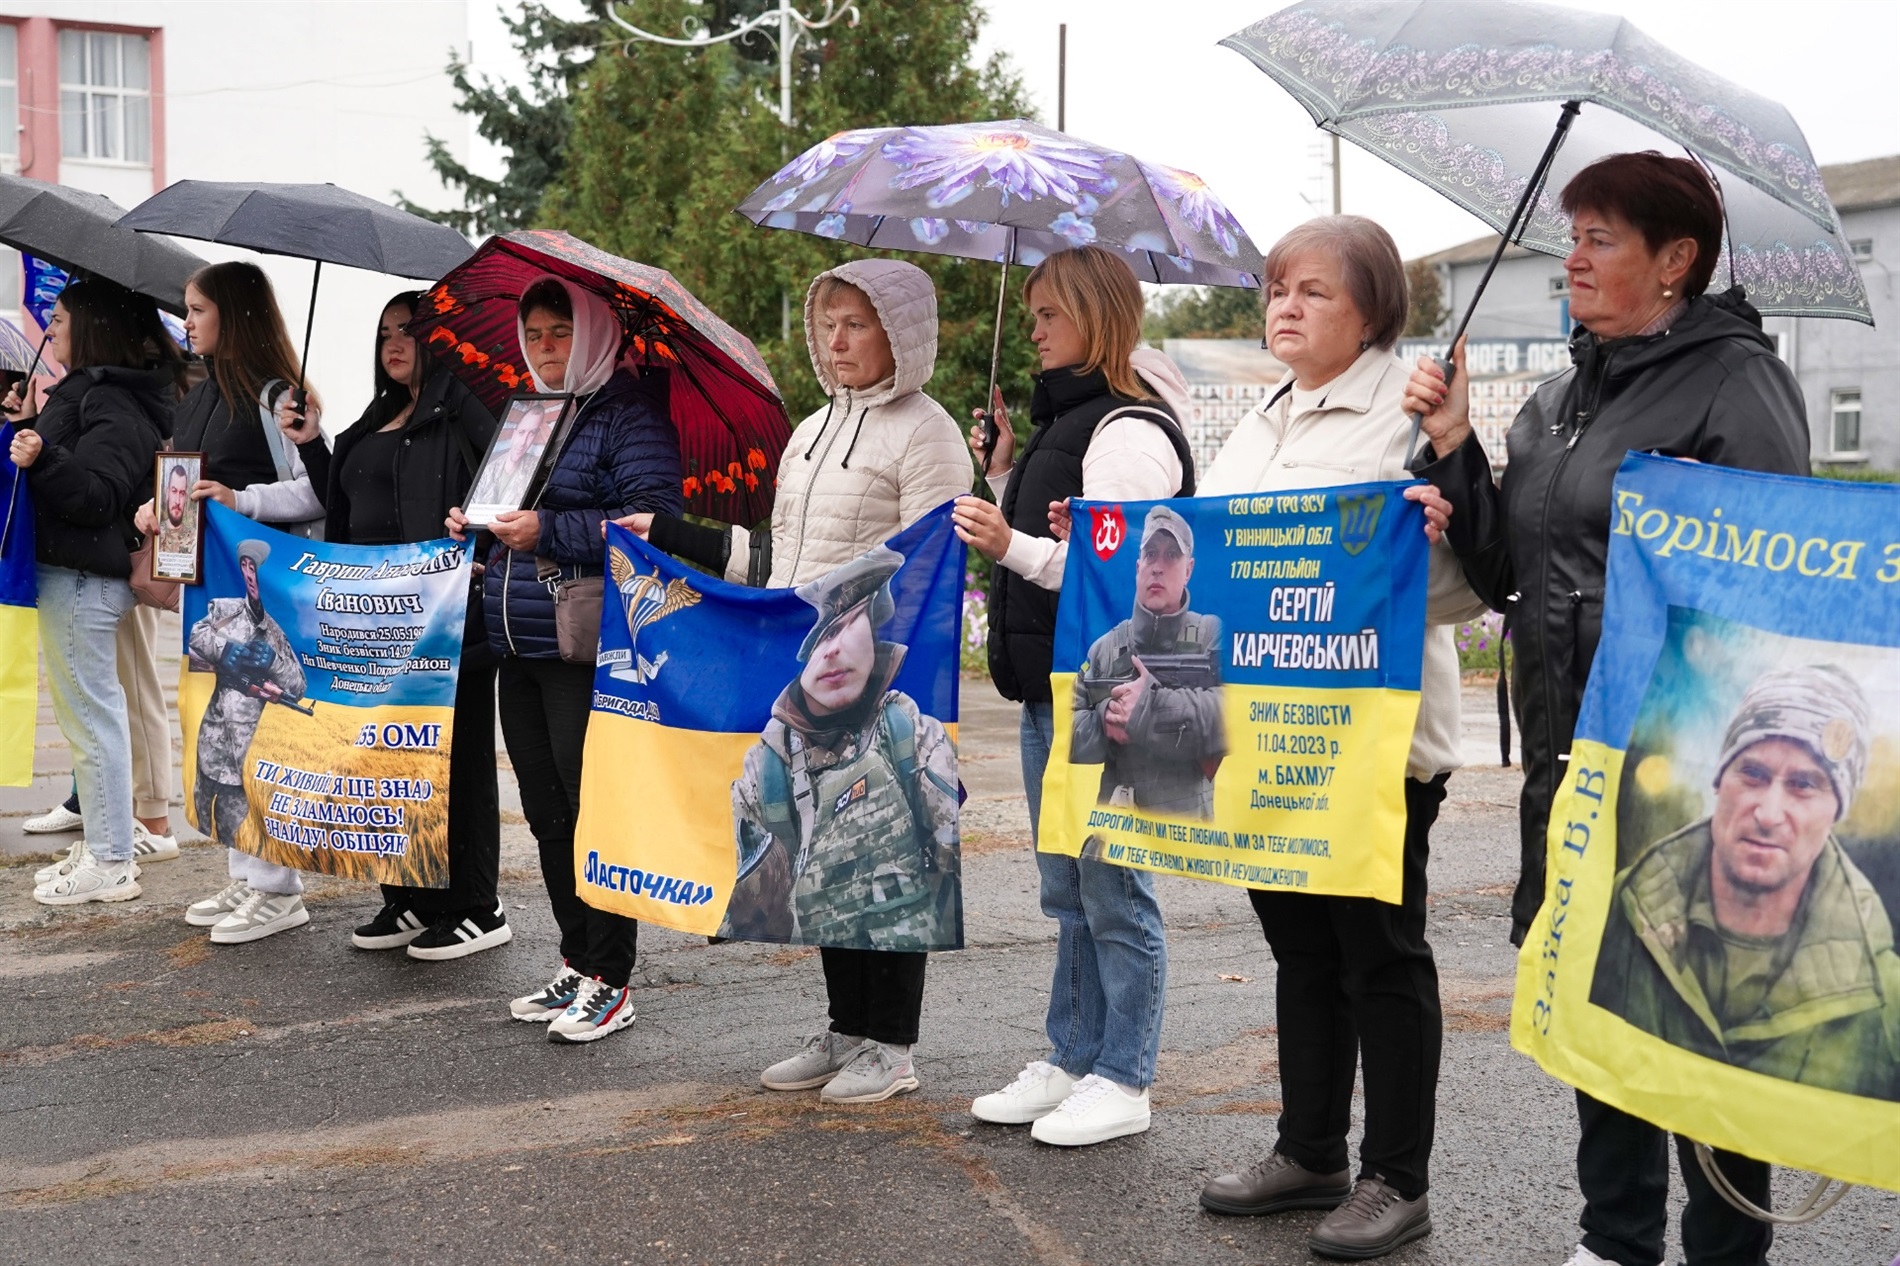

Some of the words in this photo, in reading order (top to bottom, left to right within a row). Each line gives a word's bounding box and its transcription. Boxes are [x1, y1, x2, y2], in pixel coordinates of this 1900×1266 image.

[1228, 498, 1248, 514] 120
[1251, 497, 1273, 514] ОБР
[1276, 496, 1299, 513] ТРО
[1301, 495, 1326, 512] ЗСУ
[1225, 529, 1233, 546] У
[1236, 525, 1305, 547] ВІННИЦЬКІЙ
[1306, 527, 1332, 545] ОБЛ.
[1613, 490, 1865, 580] Борімося
[289, 551, 372, 584] Гавриш
[1230, 561, 1251, 579] 170
[1252, 558, 1320, 579] БАТАЛЬЙОН
[316, 587, 423, 614] Іванович
[1269, 581, 1335, 622] СЕРГІЙ
[320, 622, 377, 642] Народився
[317, 640, 341, 655] Зник
[343, 643, 389, 658] безвісти
[1232, 629, 1379, 670] КАРЧЕВСЬКИЙ
[316, 656, 367, 675] Шевченко
[403, 656, 450, 674] район
[330, 676, 372, 694] Донецька
[1250, 701, 1280, 723] ЗНИК
[1283, 703, 1351, 725] БЕЗВІСТИ
[1257, 732, 1326, 754] 11.04.2023
[1330, 740, 1341, 760] р.
[255, 761, 280, 782] ТИ
[331, 777, 343, 795] Я
[348, 779, 375, 800] ЦЕ
[1259, 768, 1272, 784] м.
[1276, 765, 1335, 787] БАХМУТ
[270, 793, 291, 814] НЕ
[290, 799, 403, 827] ЗЛАМАЮСЬ!
[1250, 789, 1316, 811] Донецької
[264, 818, 327, 850] ЗНАЙДУ!
[1087, 810, 1134, 832] ДОРОГИЙ
[1155, 822, 1167, 839] МИ
[1168, 824, 1187, 842] ТЕБЕ
[1189, 827, 1233, 849] ЛЮБИМО,
[1233, 833, 1251, 849] МИ
[1252, 834, 1265, 851] ЗА
[1267, 835, 1287, 853] ТЕБЕ
[1108, 843, 1125, 860] МИ
[1126, 846, 1148, 864] ТЕБЕ
[1149, 850, 1184, 871] ЧЕКАЄМО
[1185, 857, 1222, 877] ЖИВОГО
